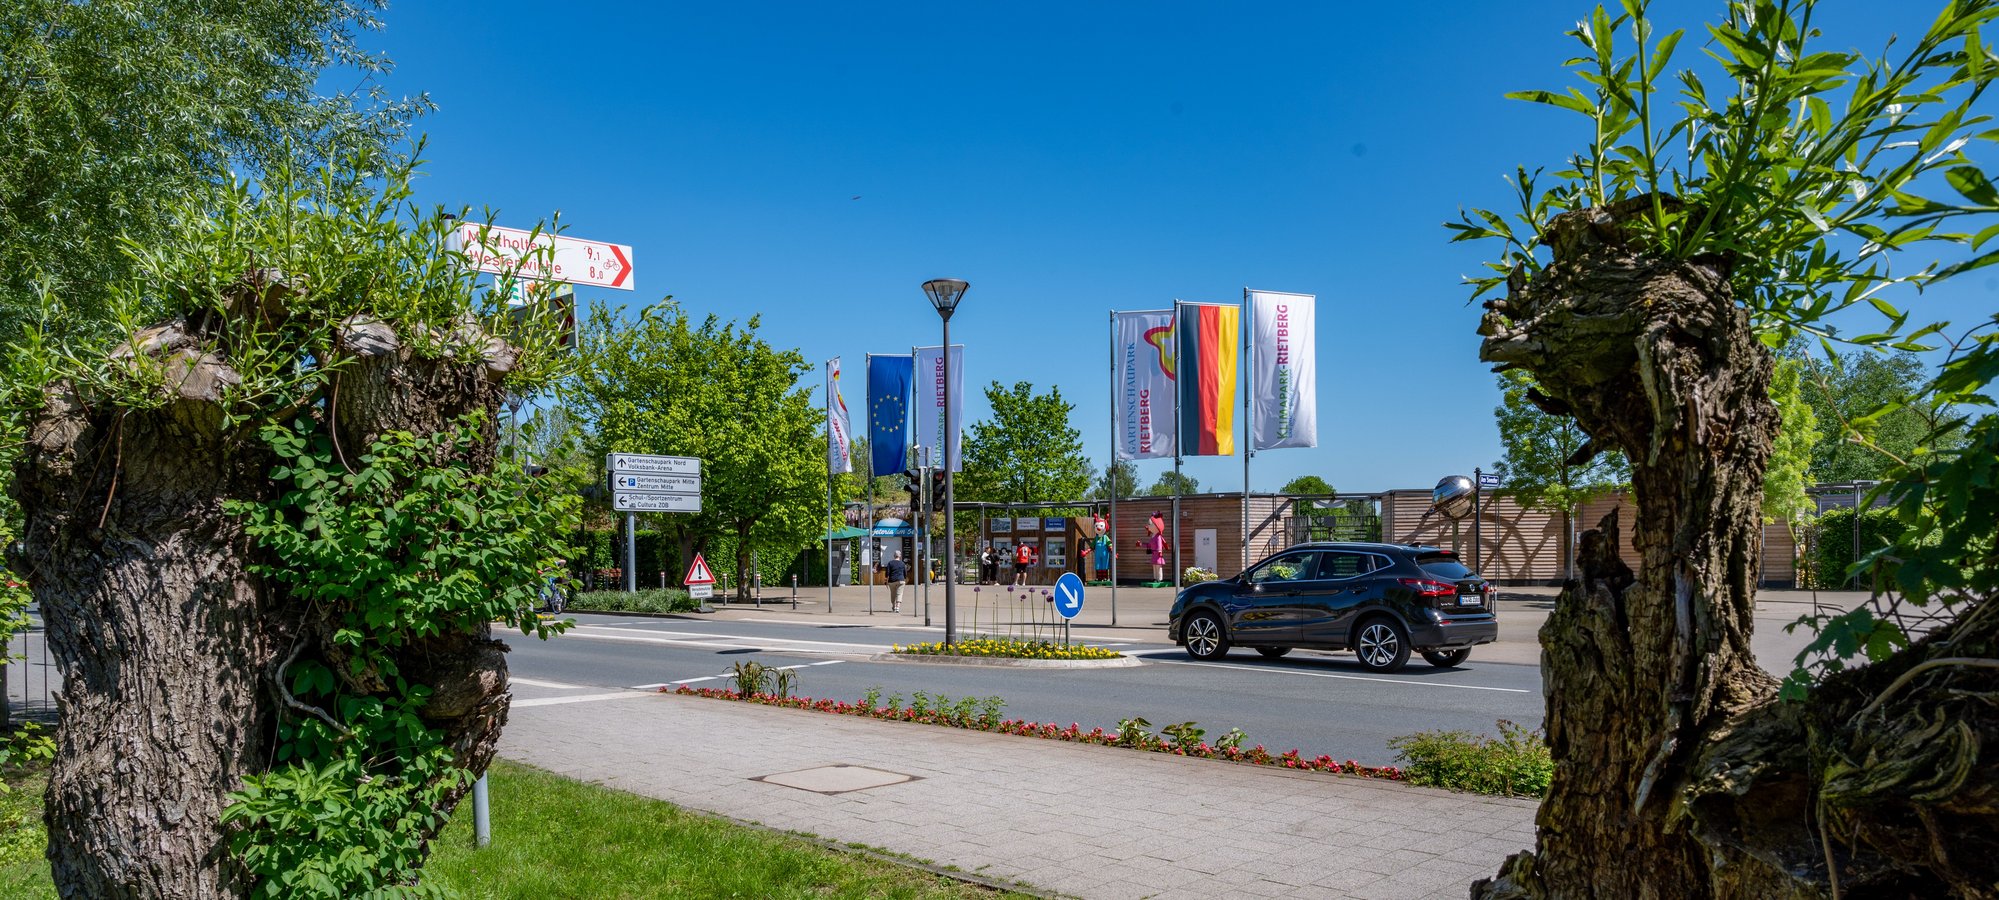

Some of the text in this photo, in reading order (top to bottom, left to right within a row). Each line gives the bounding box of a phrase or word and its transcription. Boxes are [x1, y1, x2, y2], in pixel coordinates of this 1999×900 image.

[1127, 342, 1135, 454] GARTENSCHAUPARK
[1277, 304, 1289, 440] KLIMAPARK-RIETBERG
[628, 457, 671, 465] Gartenschaupark
[1140, 388, 1151, 454] RIETBERG
